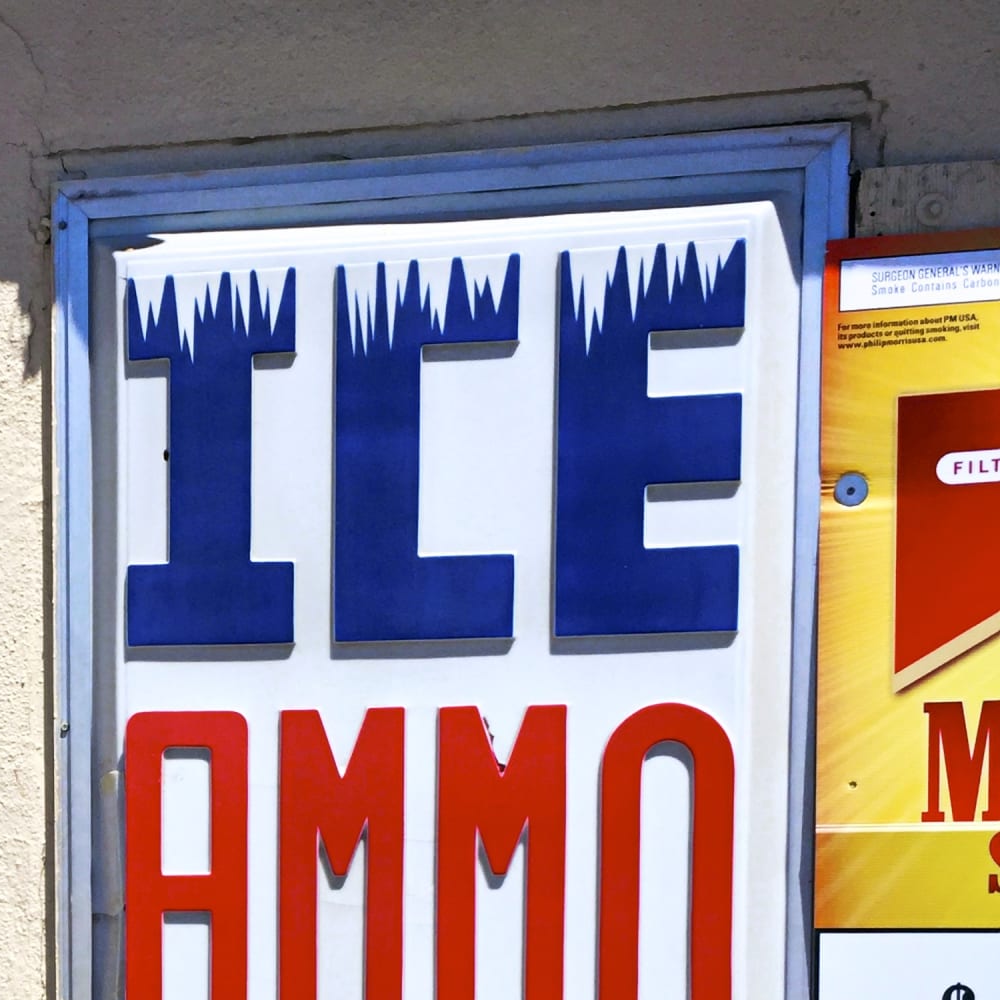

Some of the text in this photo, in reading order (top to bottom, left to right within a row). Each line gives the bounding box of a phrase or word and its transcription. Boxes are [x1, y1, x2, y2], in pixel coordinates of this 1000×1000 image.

[872, 269, 915, 283] SURGEON
[872, 277, 999, 296] Smoke Contains Carbon
[873, 319, 918, 330] information
[920, 317, 942, 325] about
[944, 315, 957, 323] PM
[848, 331, 883, 341] products
[894, 327, 925, 338] quitting
[963, 323, 980, 331] visit
[127, 239, 745, 647] ICE
